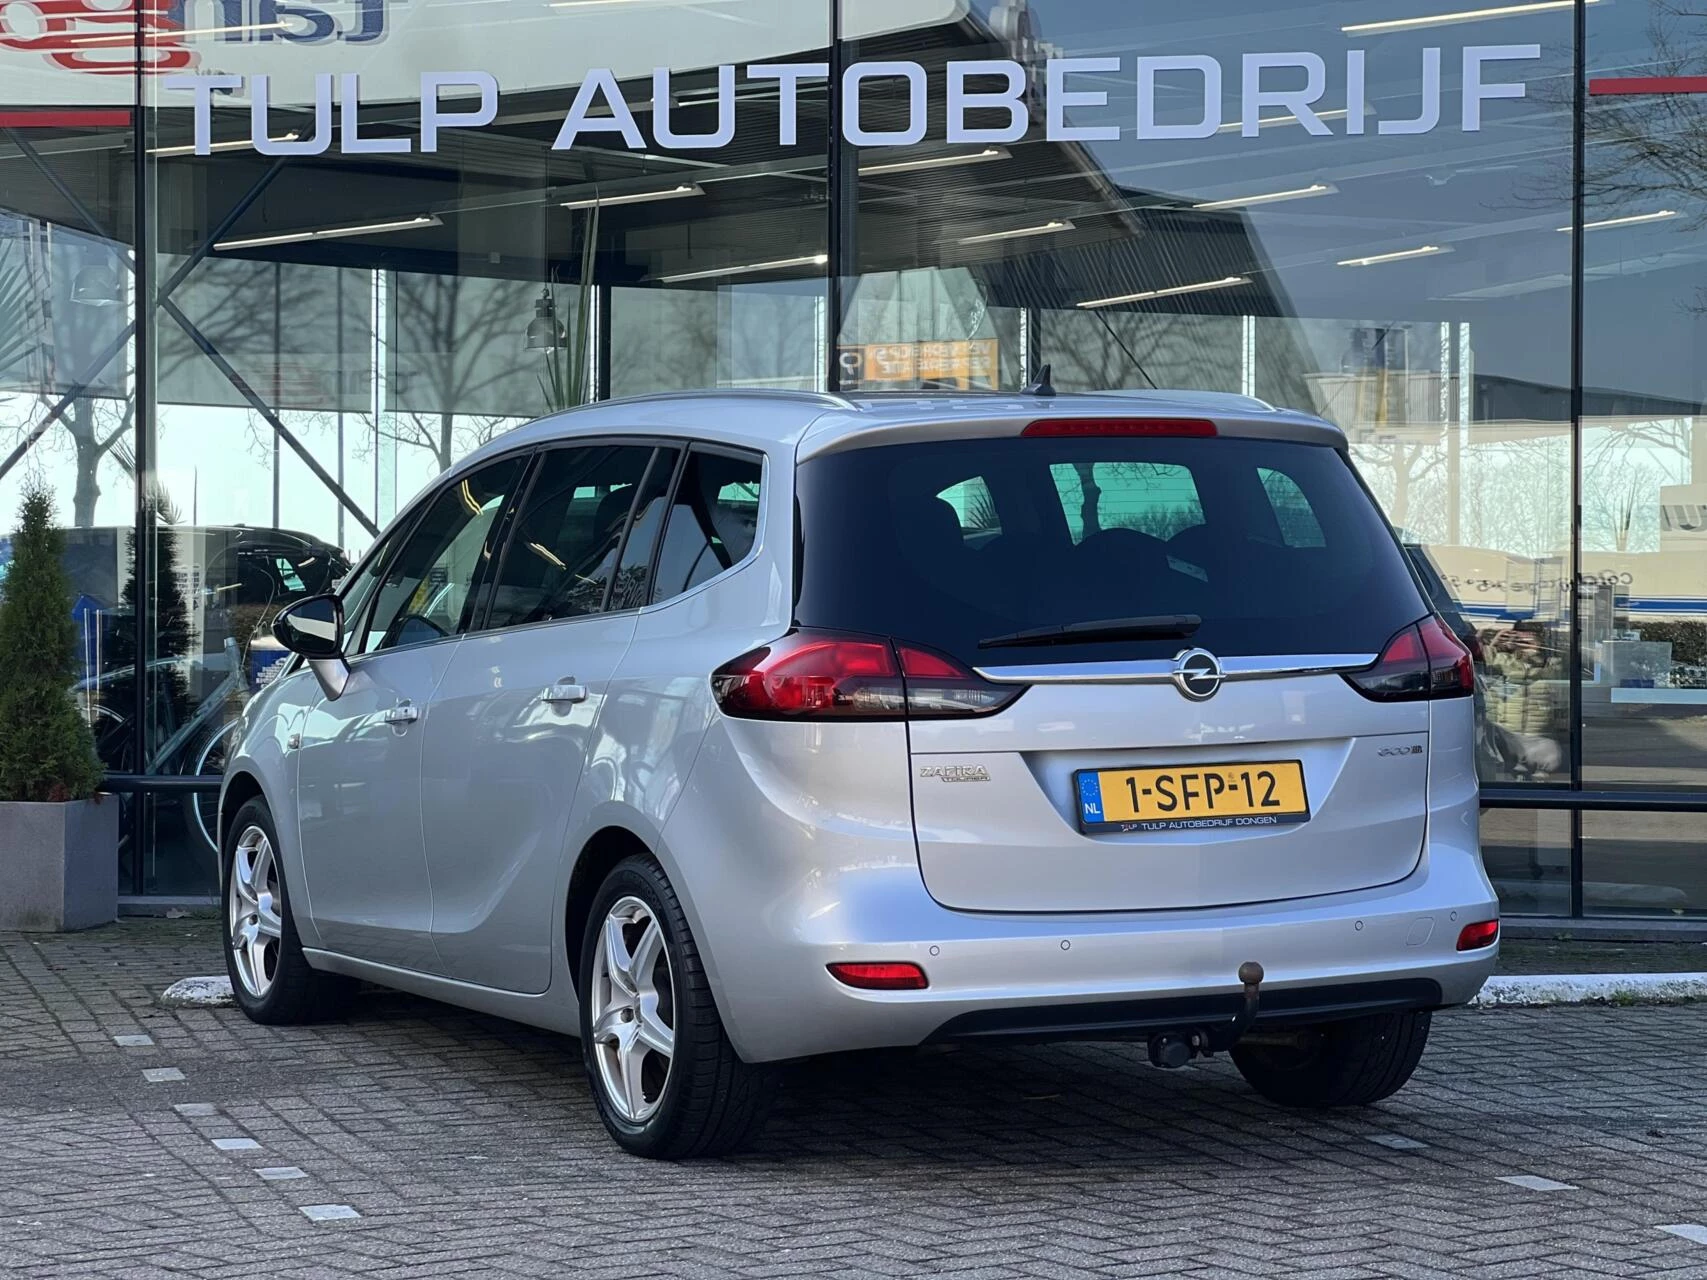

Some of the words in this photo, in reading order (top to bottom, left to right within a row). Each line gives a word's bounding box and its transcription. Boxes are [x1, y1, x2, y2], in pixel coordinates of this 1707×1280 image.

[164, 71, 498, 156] TULP
[551, 44, 1541, 150] AUTOBEDRIJF
[919, 765, 987, 778] ZAFIRA
[1126, 771, 1281, 813] 1-SFP-12
[1085, 803, 1101, 814] NL
[1141, 821, 1167, 830] TULP
[1169, 819, 1233, 829] AUTOBEDRIJF
[1236, 816, 1277, 826] DONGEN
